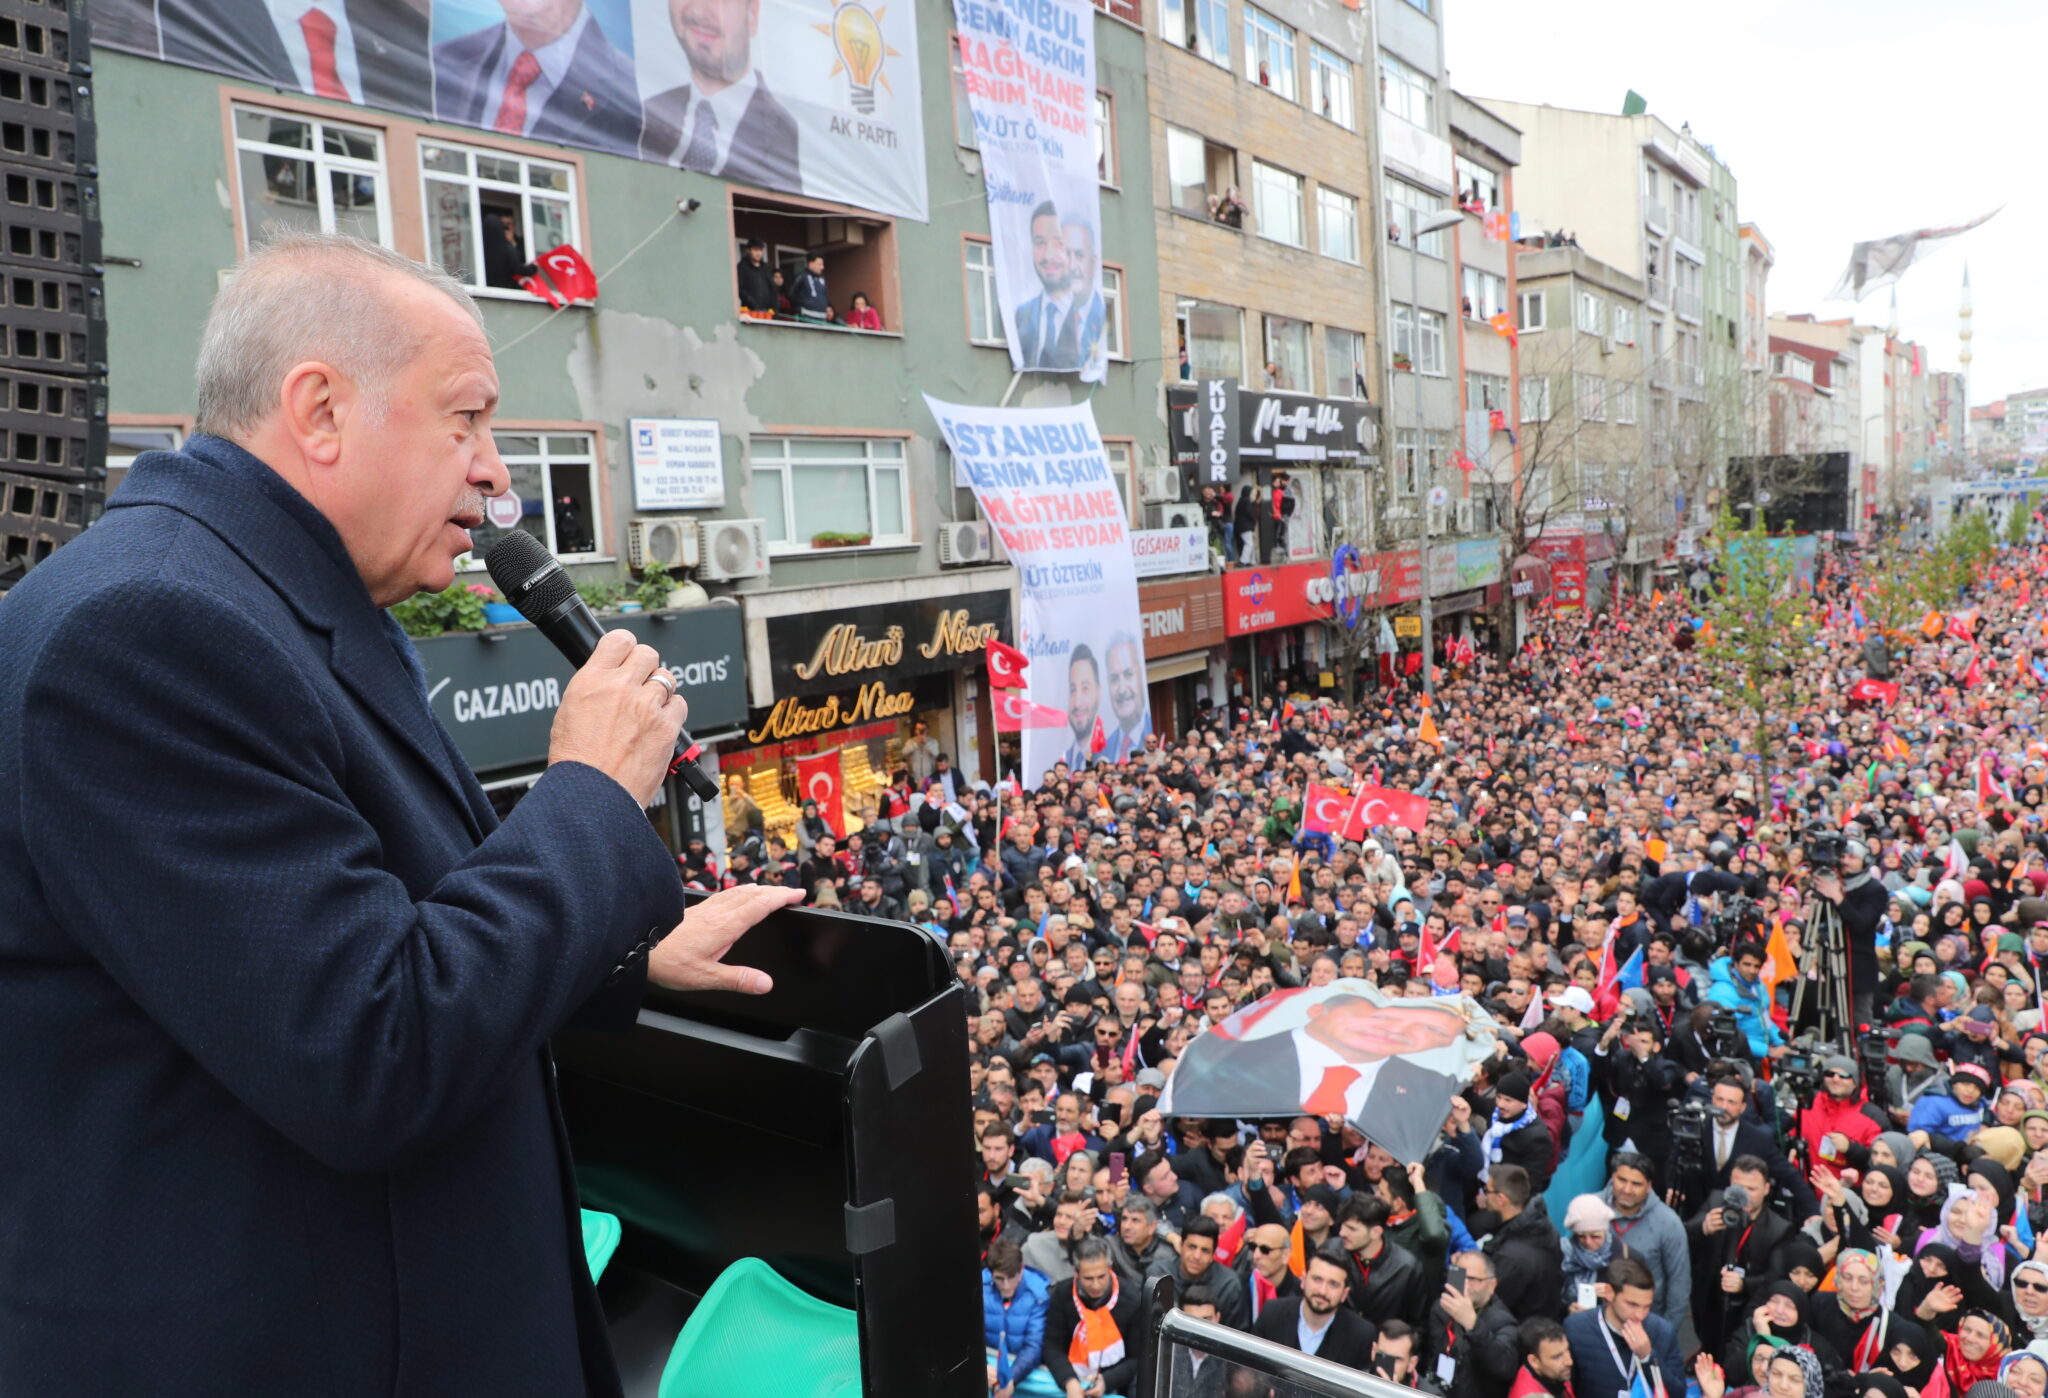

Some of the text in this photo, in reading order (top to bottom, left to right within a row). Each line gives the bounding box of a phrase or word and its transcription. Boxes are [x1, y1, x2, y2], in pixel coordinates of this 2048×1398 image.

[830, 115, 851, 136] AK
[942, 417, 1098, 457] İSTANBUL
[1044, 456, 1109, 488] AŞKIM
[1050, 522, 1124, 550] SEVDAM
[1052, 559, 1104, 584] ÖZTEKİN
[919, 609, 999, 659] Nisa
[1140, 607, 1185, 640] FIRIN
[453, 677, 560, 722] CAZADOR
[841, 680, 916, 725] Nisa
